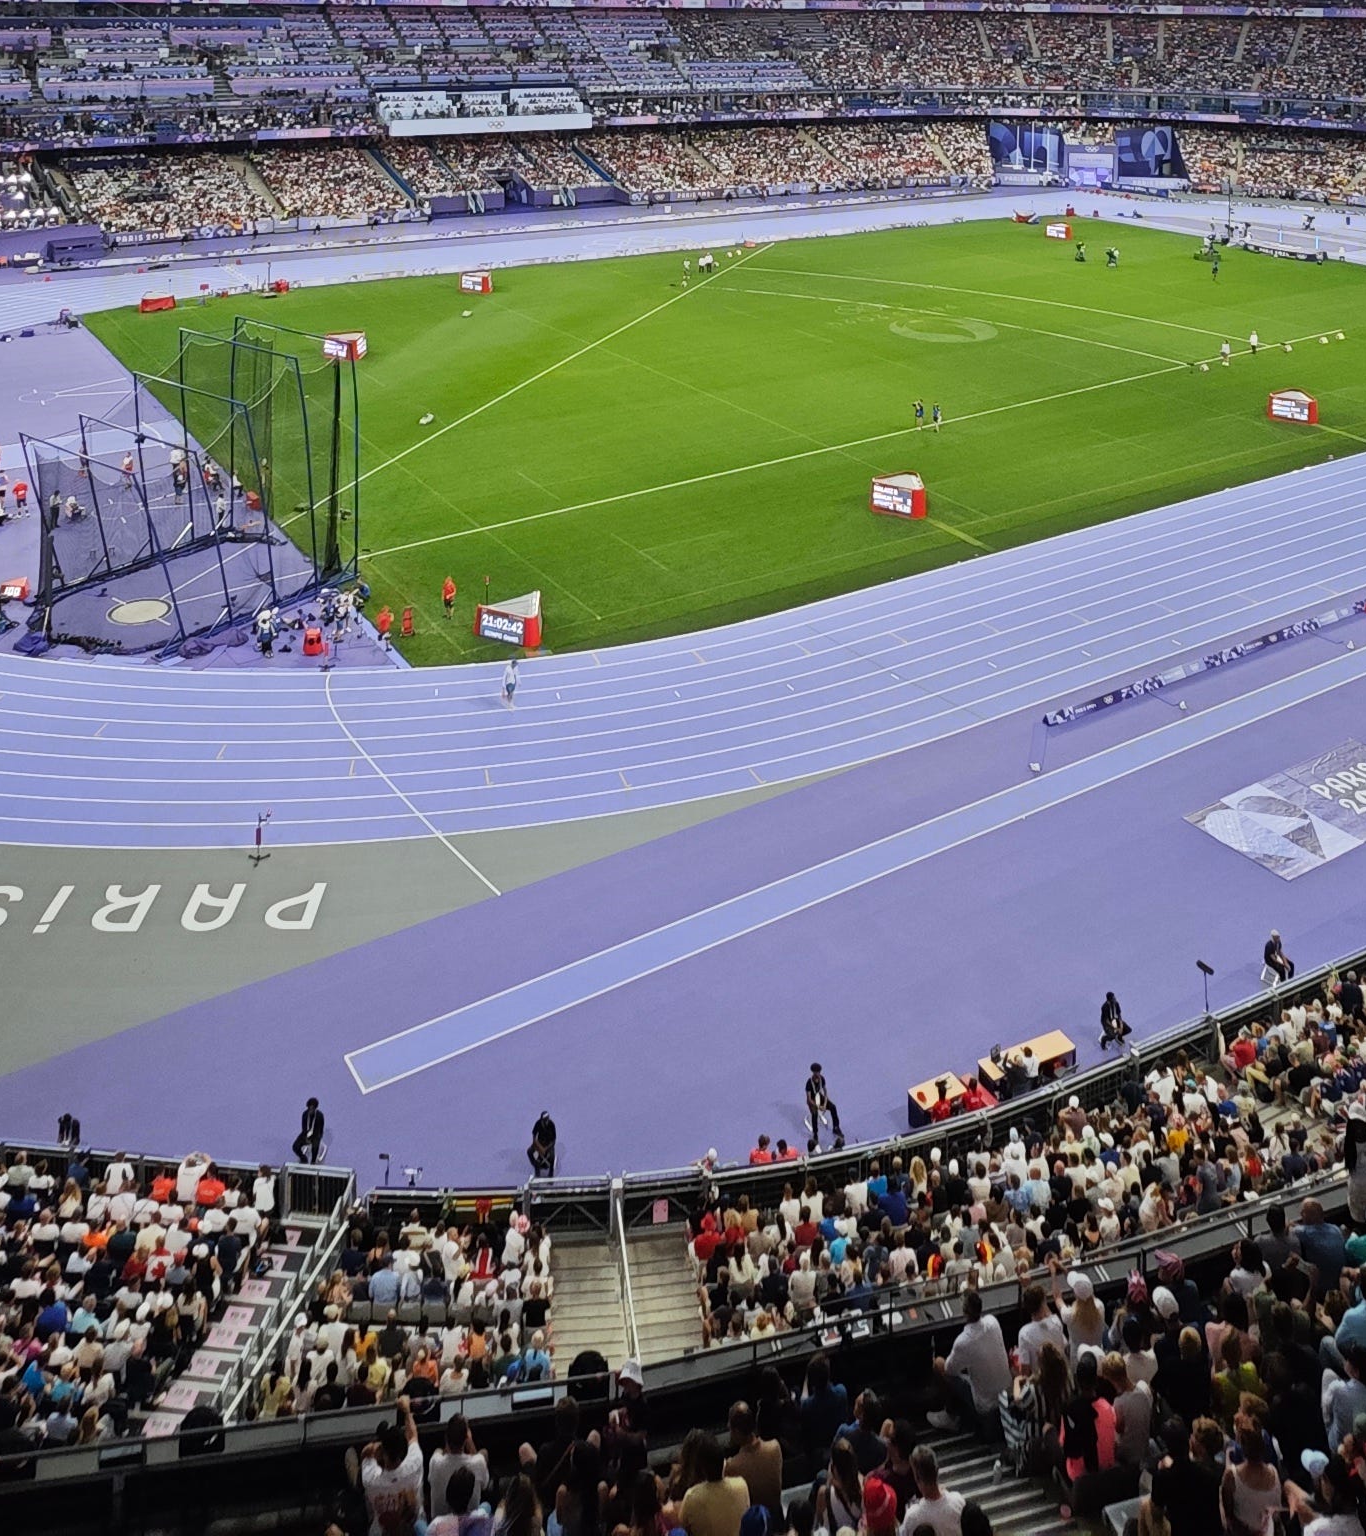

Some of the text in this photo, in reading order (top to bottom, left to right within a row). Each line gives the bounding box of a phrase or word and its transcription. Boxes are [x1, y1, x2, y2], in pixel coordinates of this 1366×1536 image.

[115, 232, 165, 243] PARIS 202
[482, 613, 524, 635] 21:02:42
